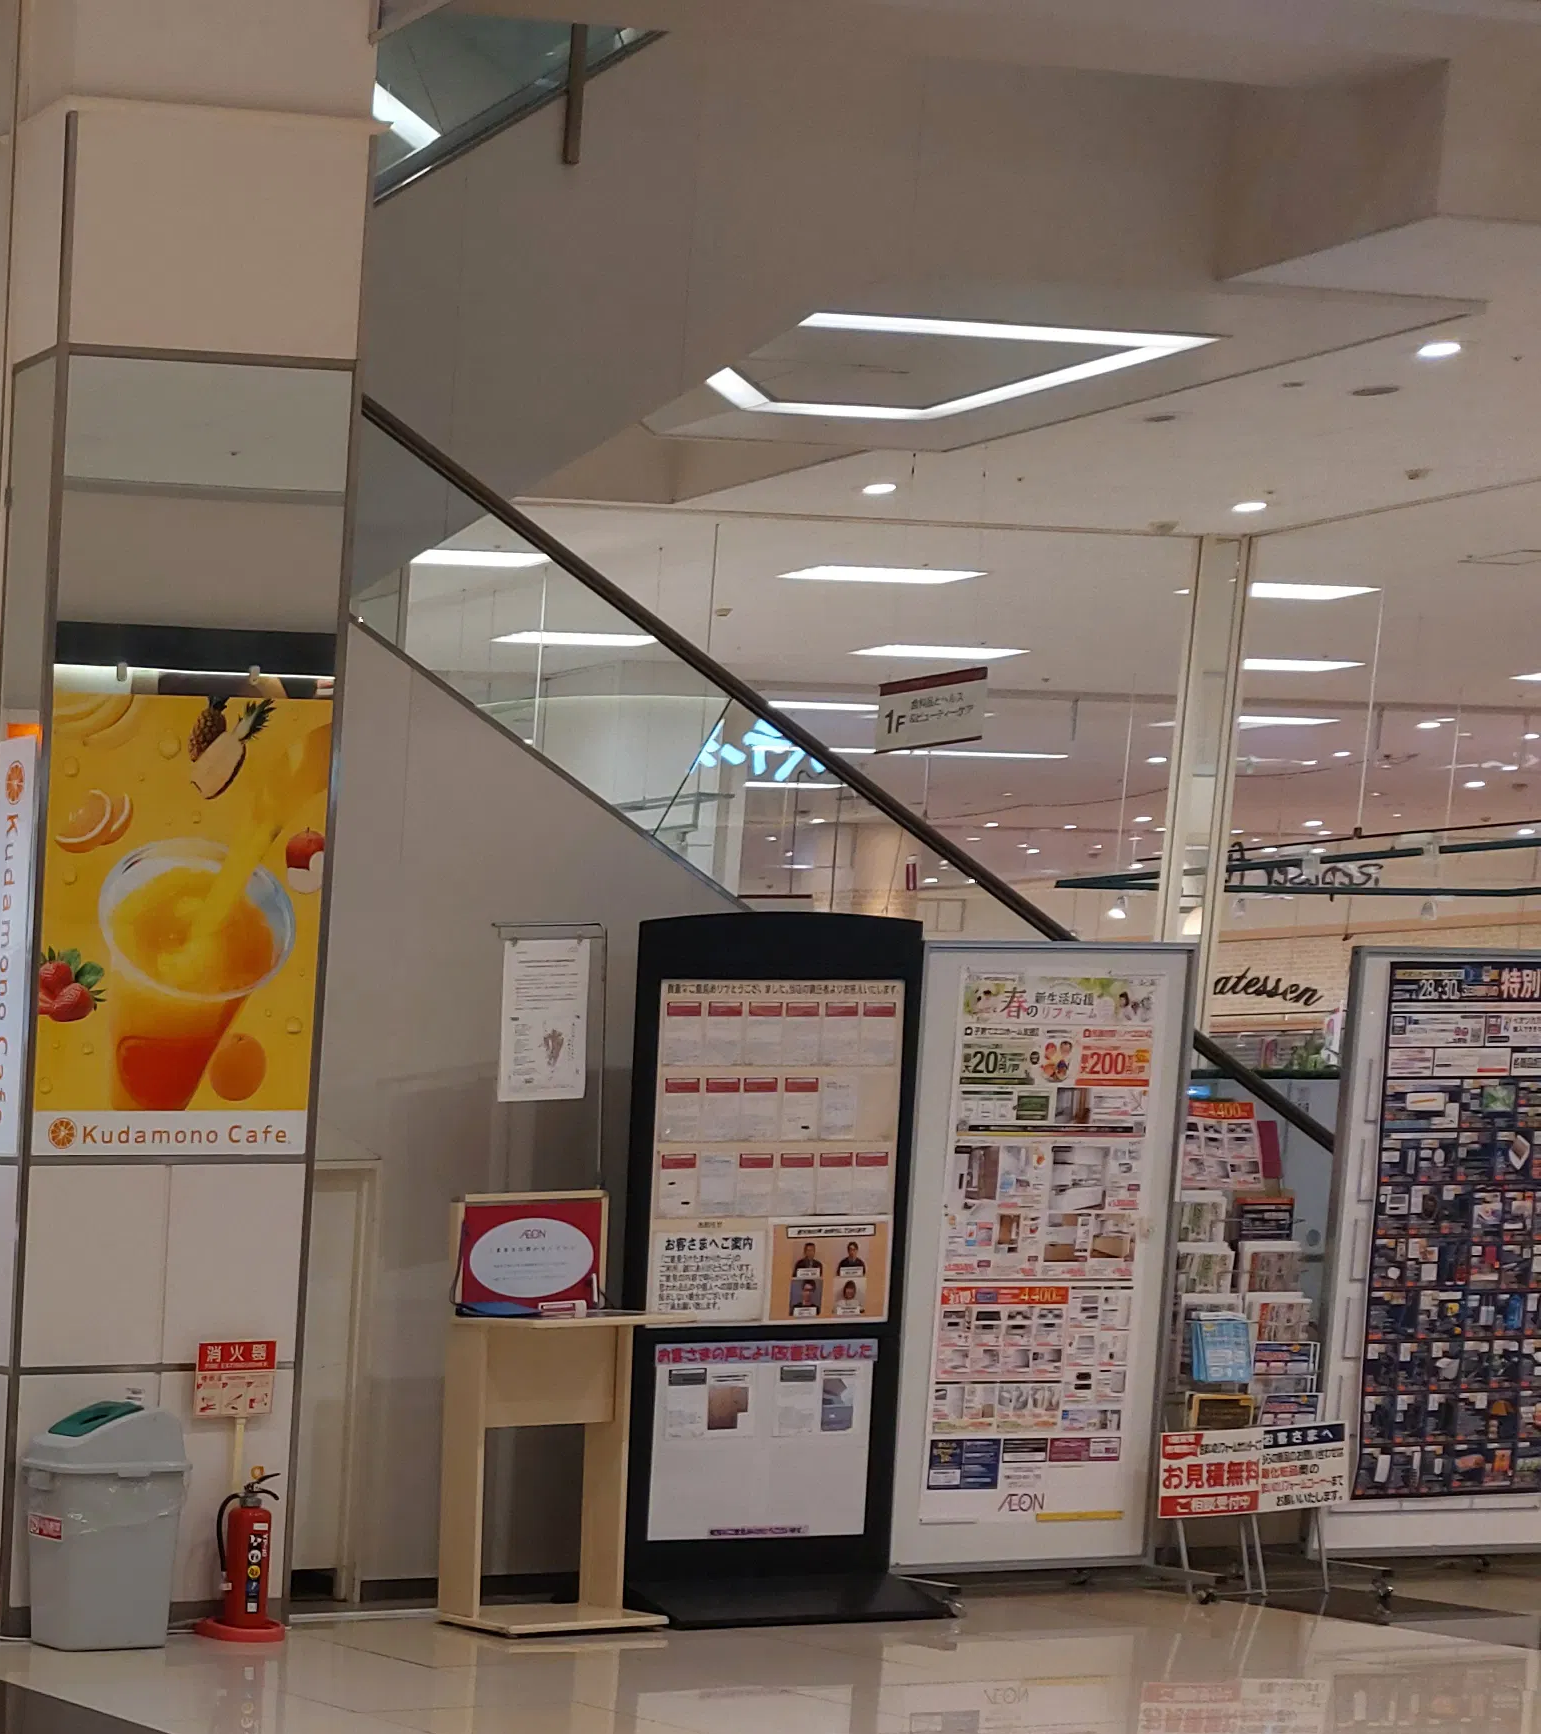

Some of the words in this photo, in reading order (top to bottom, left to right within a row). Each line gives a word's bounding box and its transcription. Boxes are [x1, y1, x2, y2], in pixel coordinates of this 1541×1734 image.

[884, 708, 907, 735] 1F
[1500, 967, 1541, 999] 特別
[972, 1050, 998, 1074] 20
[1090, 1052, 1126, 1075] 200
[82, 1124, 220, 1146] Kudamono
[664, 1236, 754, 1252] お客さまへご案内
[206, 1344, 268, 1363] 消火器
[1162, 1459, 1260, 1491] お見積無料
